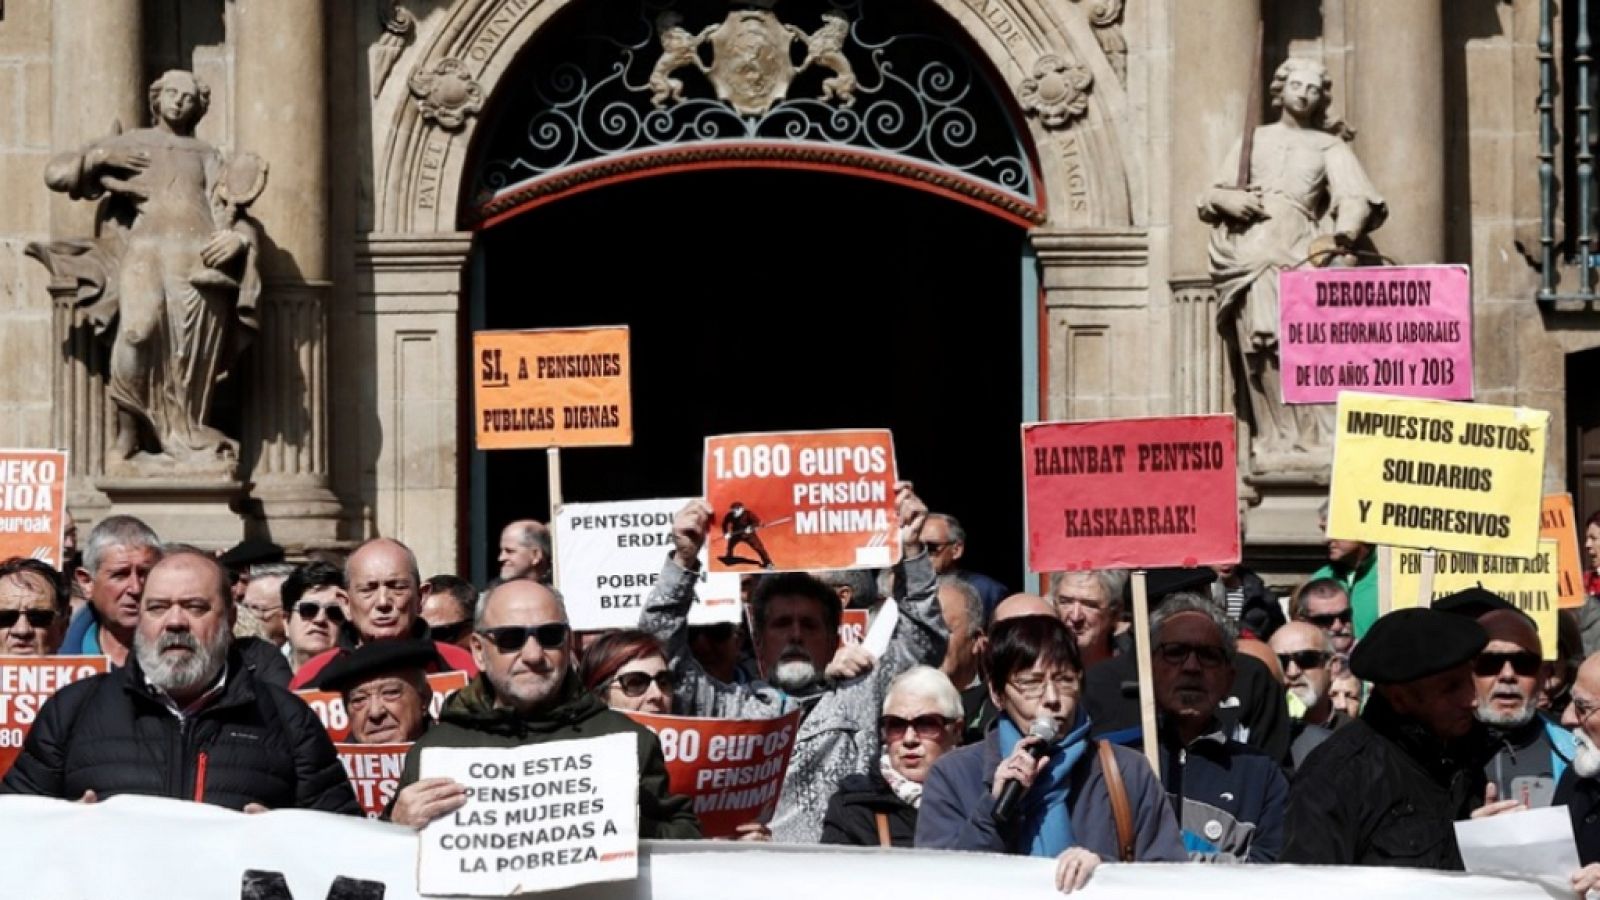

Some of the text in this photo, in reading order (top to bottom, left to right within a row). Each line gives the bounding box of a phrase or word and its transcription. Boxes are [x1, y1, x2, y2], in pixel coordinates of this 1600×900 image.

[418, 142, 442, 210] PATET
[1061, 137, 1087, 212] MAGIS
[1316, 280, 1432, 307] DEROGACION
[1289, 320, 1461, 344] DE LAS REFORMAS LABORALES
[481, 349, 621, 388] SI, A PENSIONES
[1296, 356, 1455, 387] DE LOS AÑOS 2011 Y 2013
[482, 404, 620, 433] PUBLICAS DIGNAS
[1346, 410, 1454, 443] IMPUESTOS
[713, 443, 887, 479] 1.080 euros
[1034, 440, 1224, 476] HAINBAT PENTSIO
[793, 476, 886, 505] PENSIÓN
[1382, 458, 1493, 492] SOLIDARIOS
[794, 506, 888, 535] MÍNIMA
[1064, 505, 1197, 538] KASKARRAK!
[1357, 499, 1372, 523] Y
[1381, 502, 1511, 538] PROGRESIVOS
[1400, 552, 1447, 574] PENIO
[1450, 552, 1479, 574] DUIN
[600, 594, 642, 609] BIZI
[647, 724, 793, 762] 80 euros
[469, 754, 593, 780] CON ESTAS
[696, 754, 783, 790] PENSIÓN
[465, 777, 598, 803] PENSIONES,
[454, 798, 604, 827] LAS MUJERES
[440, 818, 618, 850] CONDENADAS A
[459, 856, 488, 873] LA
[496, 846, 599, 873] POBREZA
